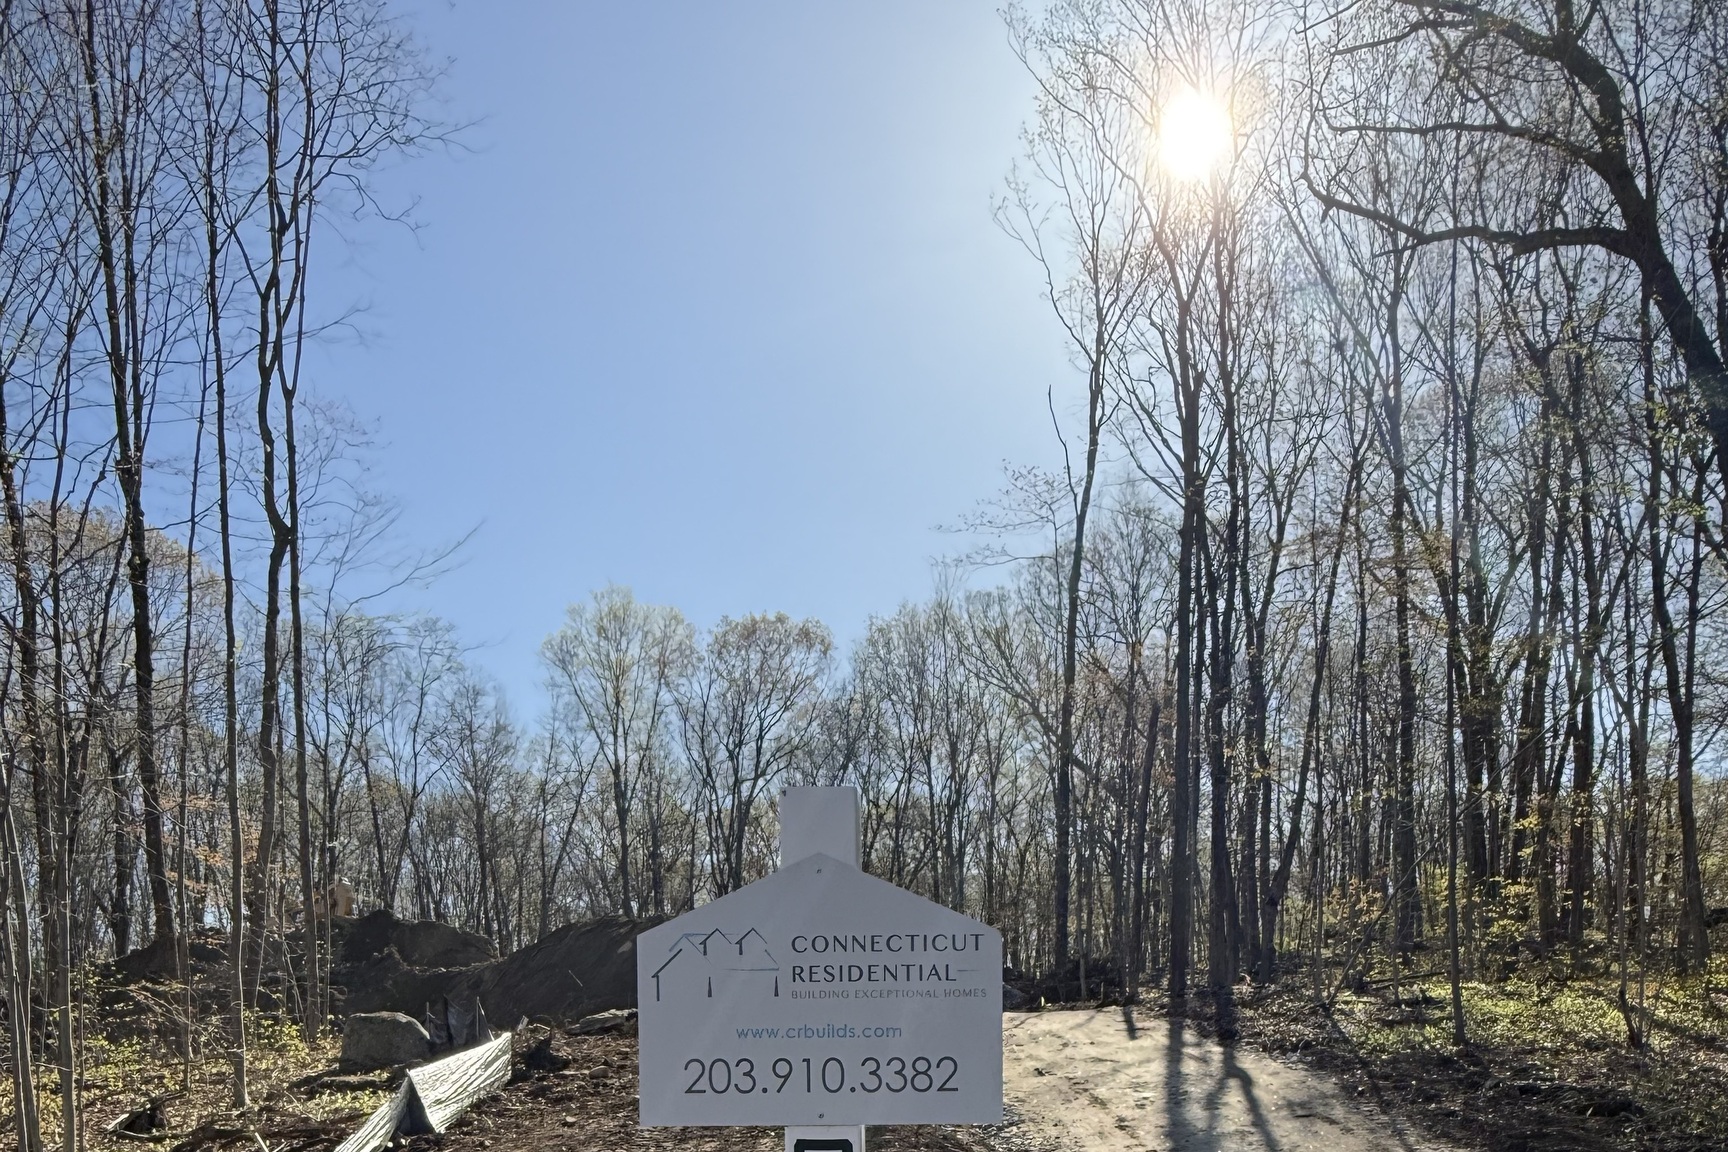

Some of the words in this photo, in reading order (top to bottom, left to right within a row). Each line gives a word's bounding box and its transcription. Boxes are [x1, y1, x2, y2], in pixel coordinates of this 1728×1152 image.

[791, 933, 985, 954] CONNECTICUT
[792, 963, 957, 983] RESIDENTIAL
[791, 989, 850, 1000] BUILDING
[854, 988, 940, 999] EXCEPTIONAL
[943, 988, 987, 998] HOMES
[736, 1023, 903, 1040] www.crbuilds.com
[684, 1056, 960, 1095] 203.910.3382
